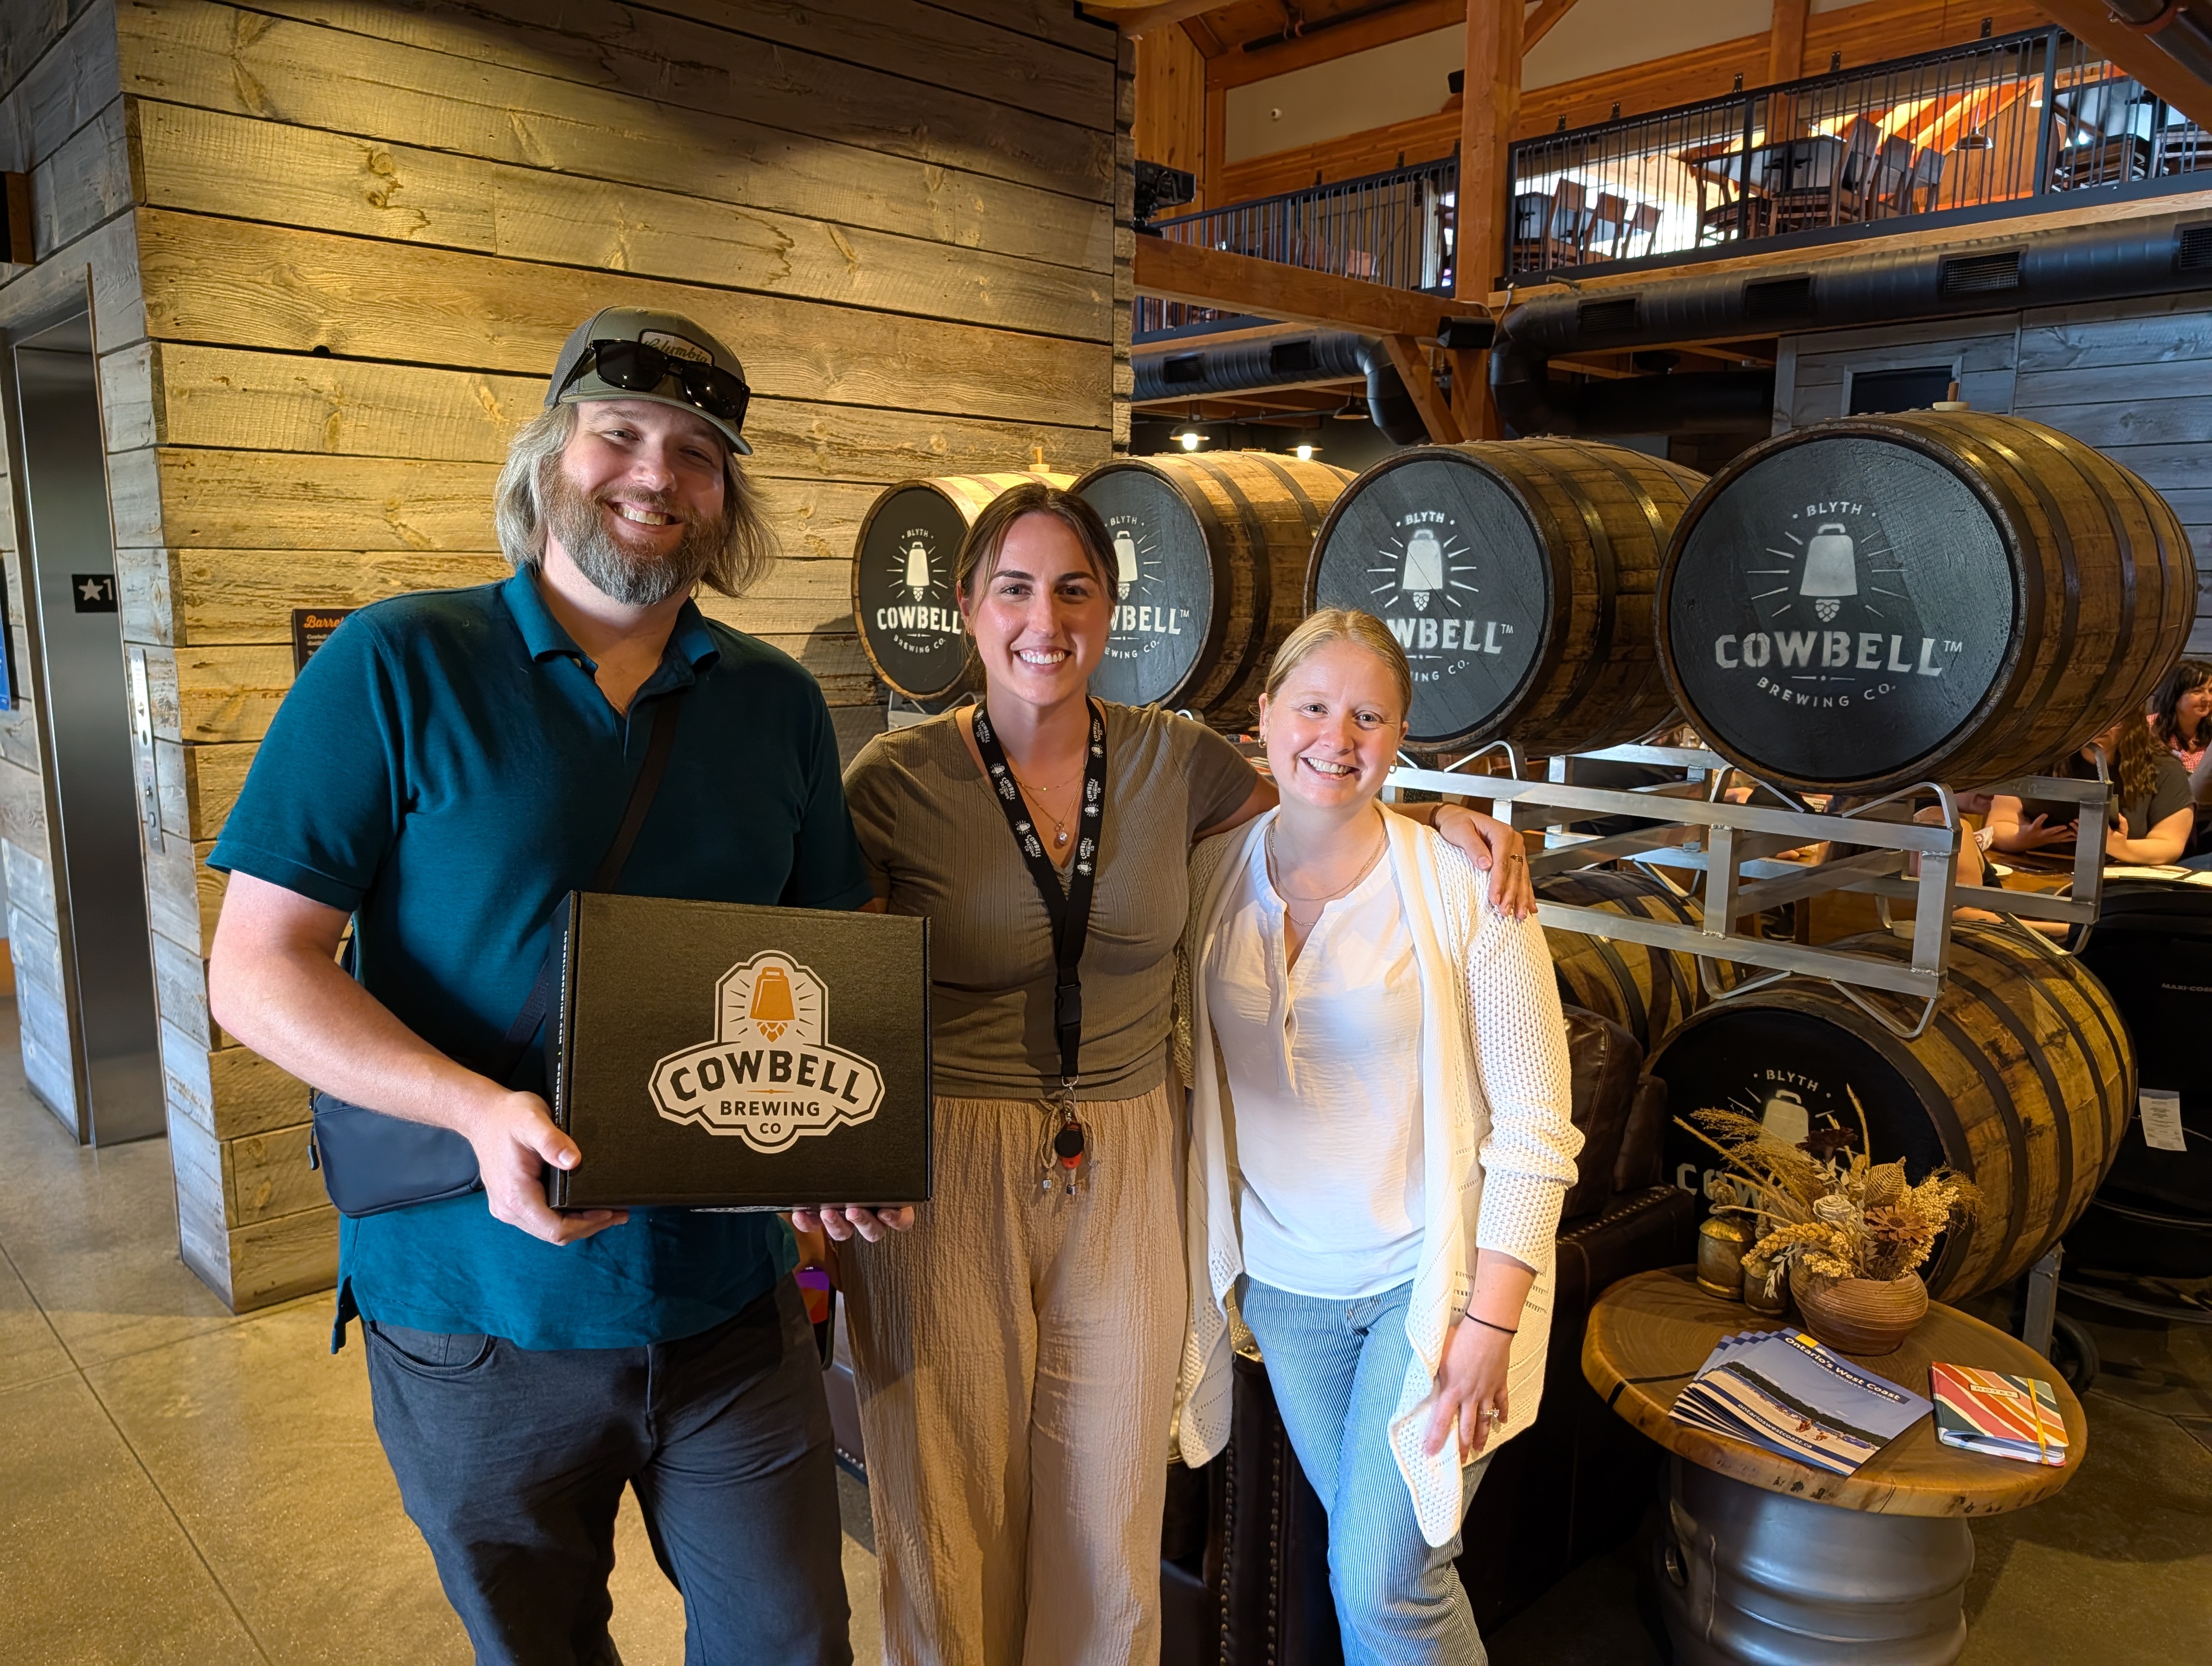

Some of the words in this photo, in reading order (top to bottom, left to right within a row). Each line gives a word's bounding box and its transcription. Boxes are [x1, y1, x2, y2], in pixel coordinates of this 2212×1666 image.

[1110, 515, 1137, 526] BLYTH
[1405, 511, 1445, 525] BLYTH
[1806, 501, 1863, 517] BLYTH
[906, 528, 929, 538] BLYTH
[104, 579, 114, 601] 1
[876, 606, 962, 635] COWBELL
[1110, 605, 1181, 635] BELL
[893, 633, 930, 653] BREWING
[933, 637, 946, 649] CO.
[1386, 618, 1503, 655] WBELL
[1104, 647, 1138, 659] EWING
[1143, 640, 1160, 653] CO.
[1714, 630, 1943, 677] COWBELL
[1448, 659, 1469, 675] CO.
[1757, 676, 1850, 707] BREWING
[1863, 683, 1897, 700] CO.
[979, 720, 991, 743] COWBELL
[1001, 777, 1015, 800] COWBELL
[1086, 778, 1096, 802] COWBELL
[1026, 834, 1041, 857] COWBELL
[1079, 837, 1090, 859] COWBELL
[670, 1049, 860, 1105] COWBELL
[1766, 1068, 1819, 1092] BLYTH
[720, 1100, 820, 1117] BREWING
[759, 1122, 782, 1135] CO
[1785, 1337, 1834, 1369] Ontario's
[1836, 1367, 1864, 1385] West
[1866, 1383, 1901, 1401] Coast
[1811, 1359, 1834, 1375] HURON
[1835, 1374, 1862, 1389] COUNTY
[1868, 1389, 1896, 1404] CANADA
[1975, 1387, 2012, 1396] NOTES
[1738, 1404, 1812, 1449] ontarioswestcoast.ca
